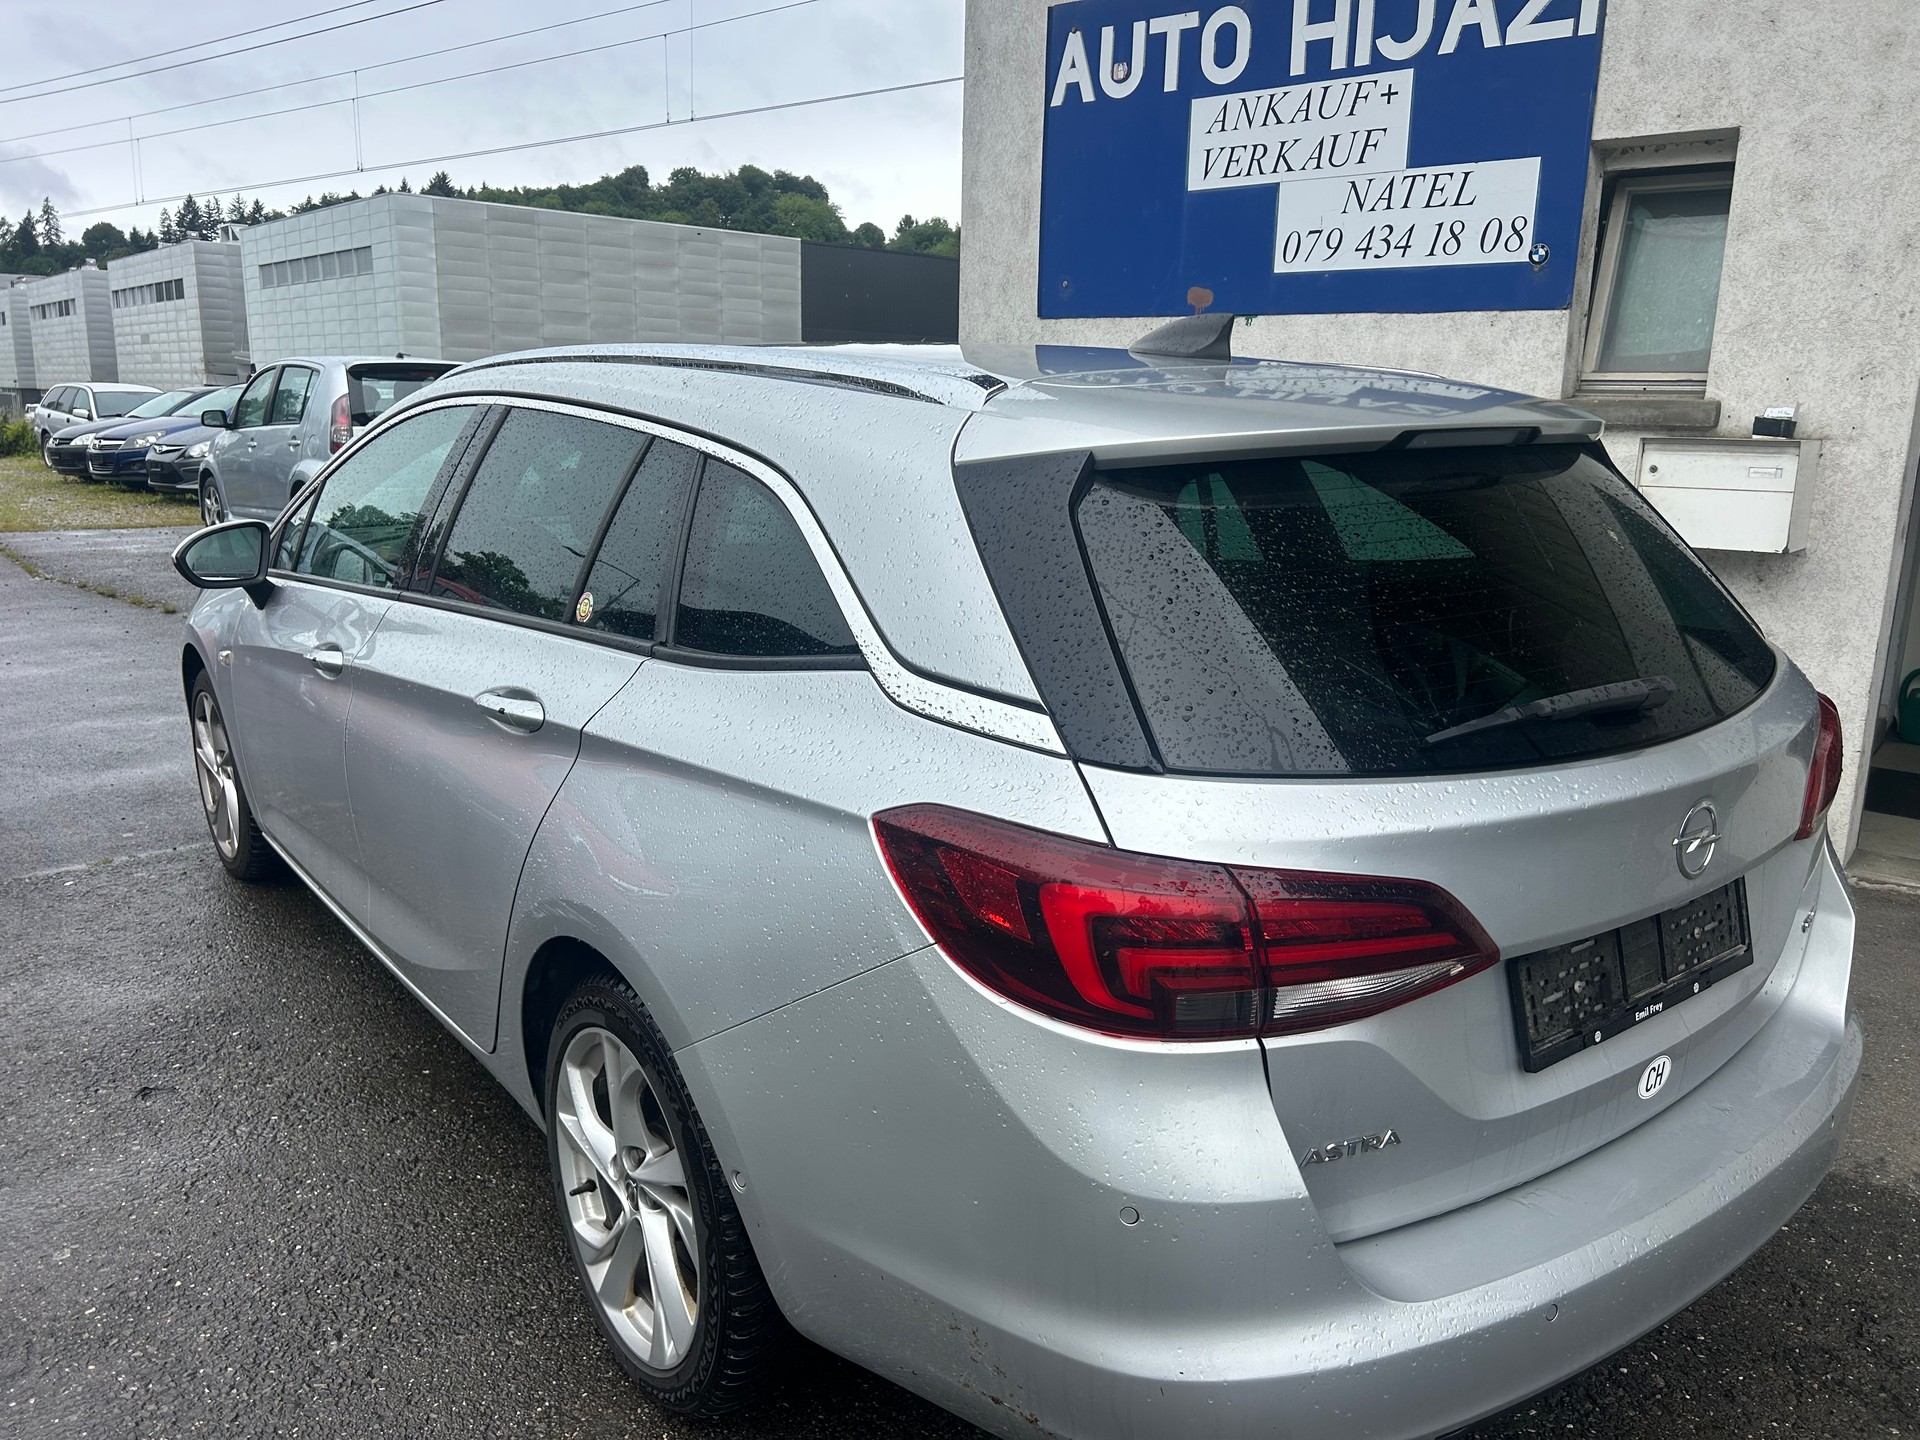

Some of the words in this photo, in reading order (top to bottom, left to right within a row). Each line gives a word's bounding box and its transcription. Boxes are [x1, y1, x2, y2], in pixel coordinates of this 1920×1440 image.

[1050, 5, 1251, 107] AUTO
[1203, 127, 1388, 180] VERKAUF
[1341, 170, 1478, 214] NATEL
[1282, 227, 1344, 264] 079
[1354, 223, 1416, 260] 434
[1425, 219, 1466, 257] 18
[1480, 215, 1528, 254] 08
[1635, 1007, 1649, 1021] Emil
[1650, 1002, 1663, 1014] Frey
[1645, 1060, 1666, 1093] CH
[1299, 1129, 1402, 1168] ASTRA
